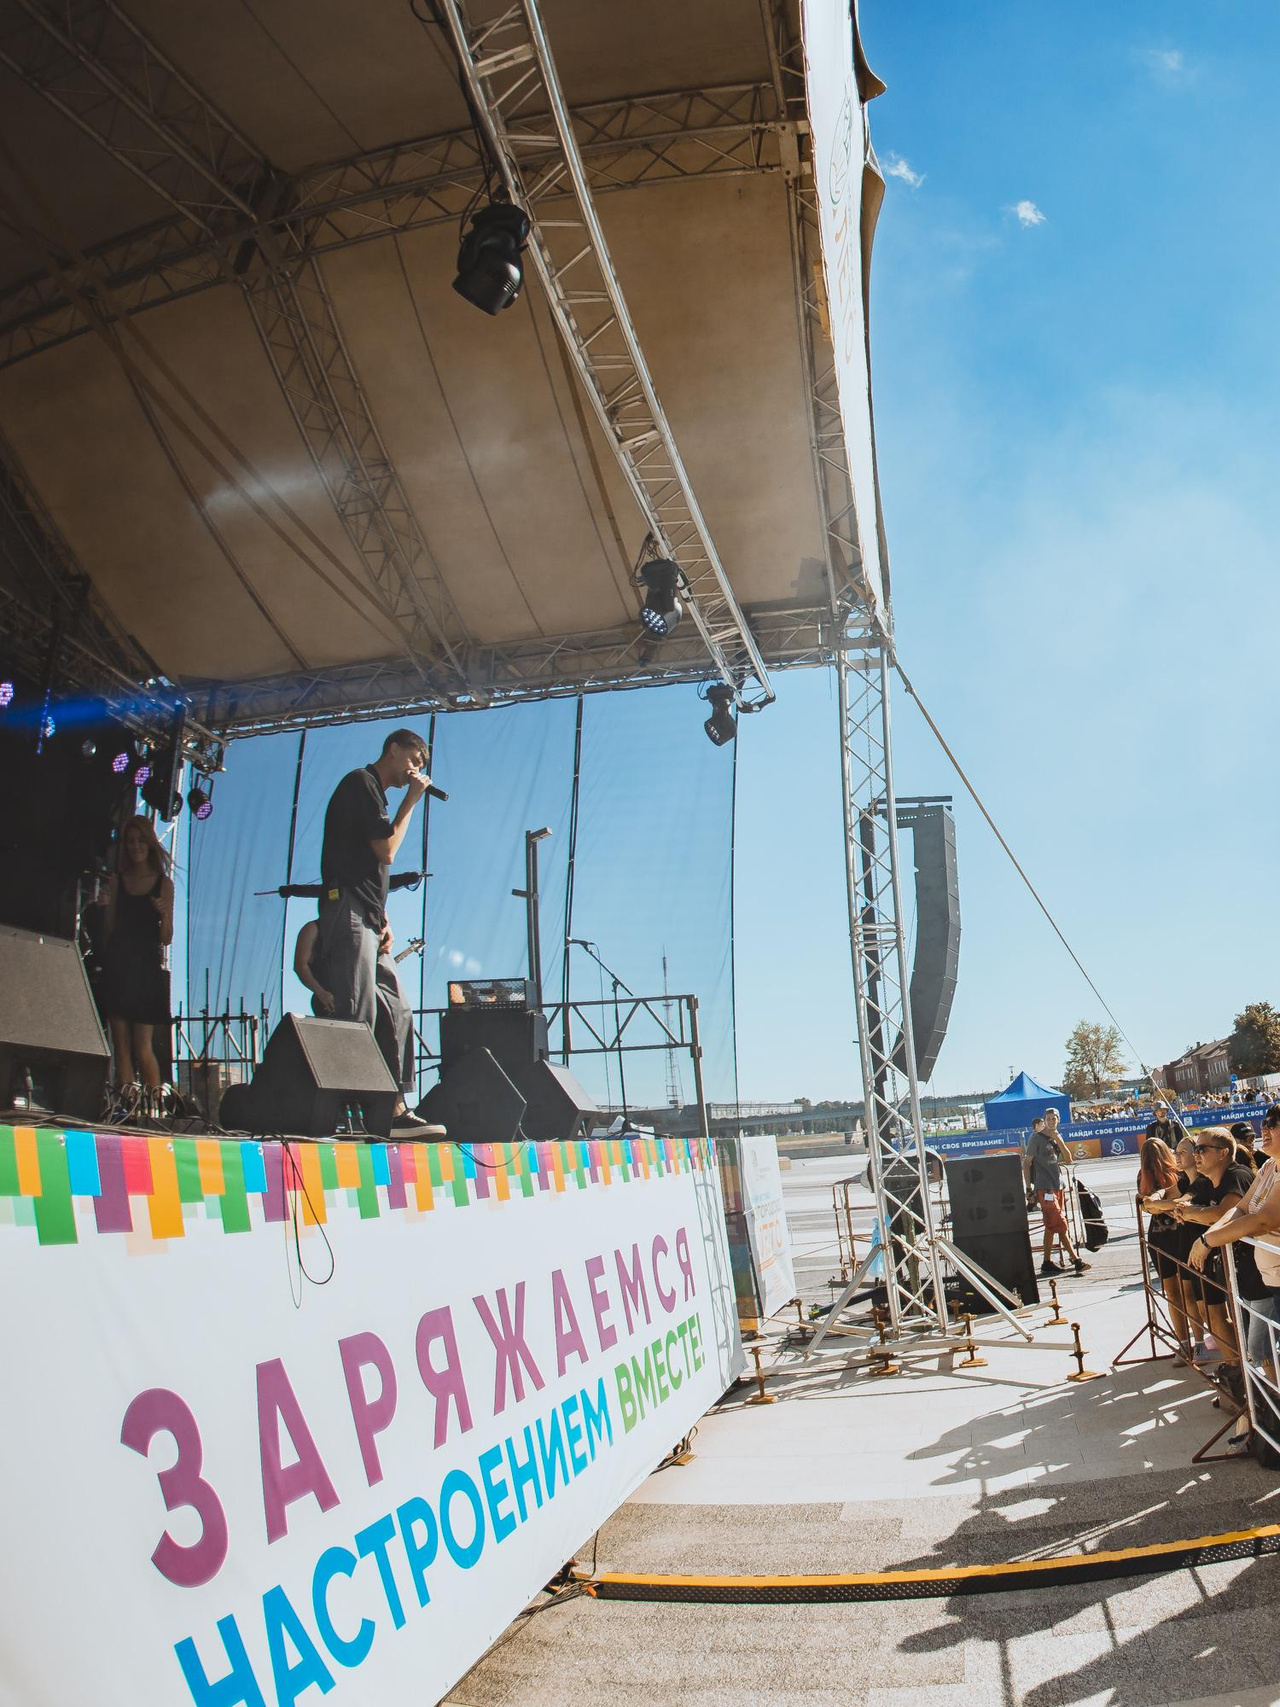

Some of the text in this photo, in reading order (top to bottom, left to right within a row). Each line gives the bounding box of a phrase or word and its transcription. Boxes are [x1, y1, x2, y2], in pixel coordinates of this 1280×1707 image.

[1221, 1112, 1245, 1122] НАЙДИ
[1246, 1109, 1264, 1118] СВОЕ
[1068, 1127, 1094, 1138] НАЙДИ
[1094, 1126, 1113, 1136] СВОЕ
[941, 1142, 961, 1150] СВОЕ
[961, 1138, 1006, 1149] ПРИЗВАНИЕ!
[120, 1227, 697, 1588] ЗАРЯЖАЕМСЯ
[174, 1311, 706, 1707] НАСТРОЕНИЕМ ВМЕСТЕ!
